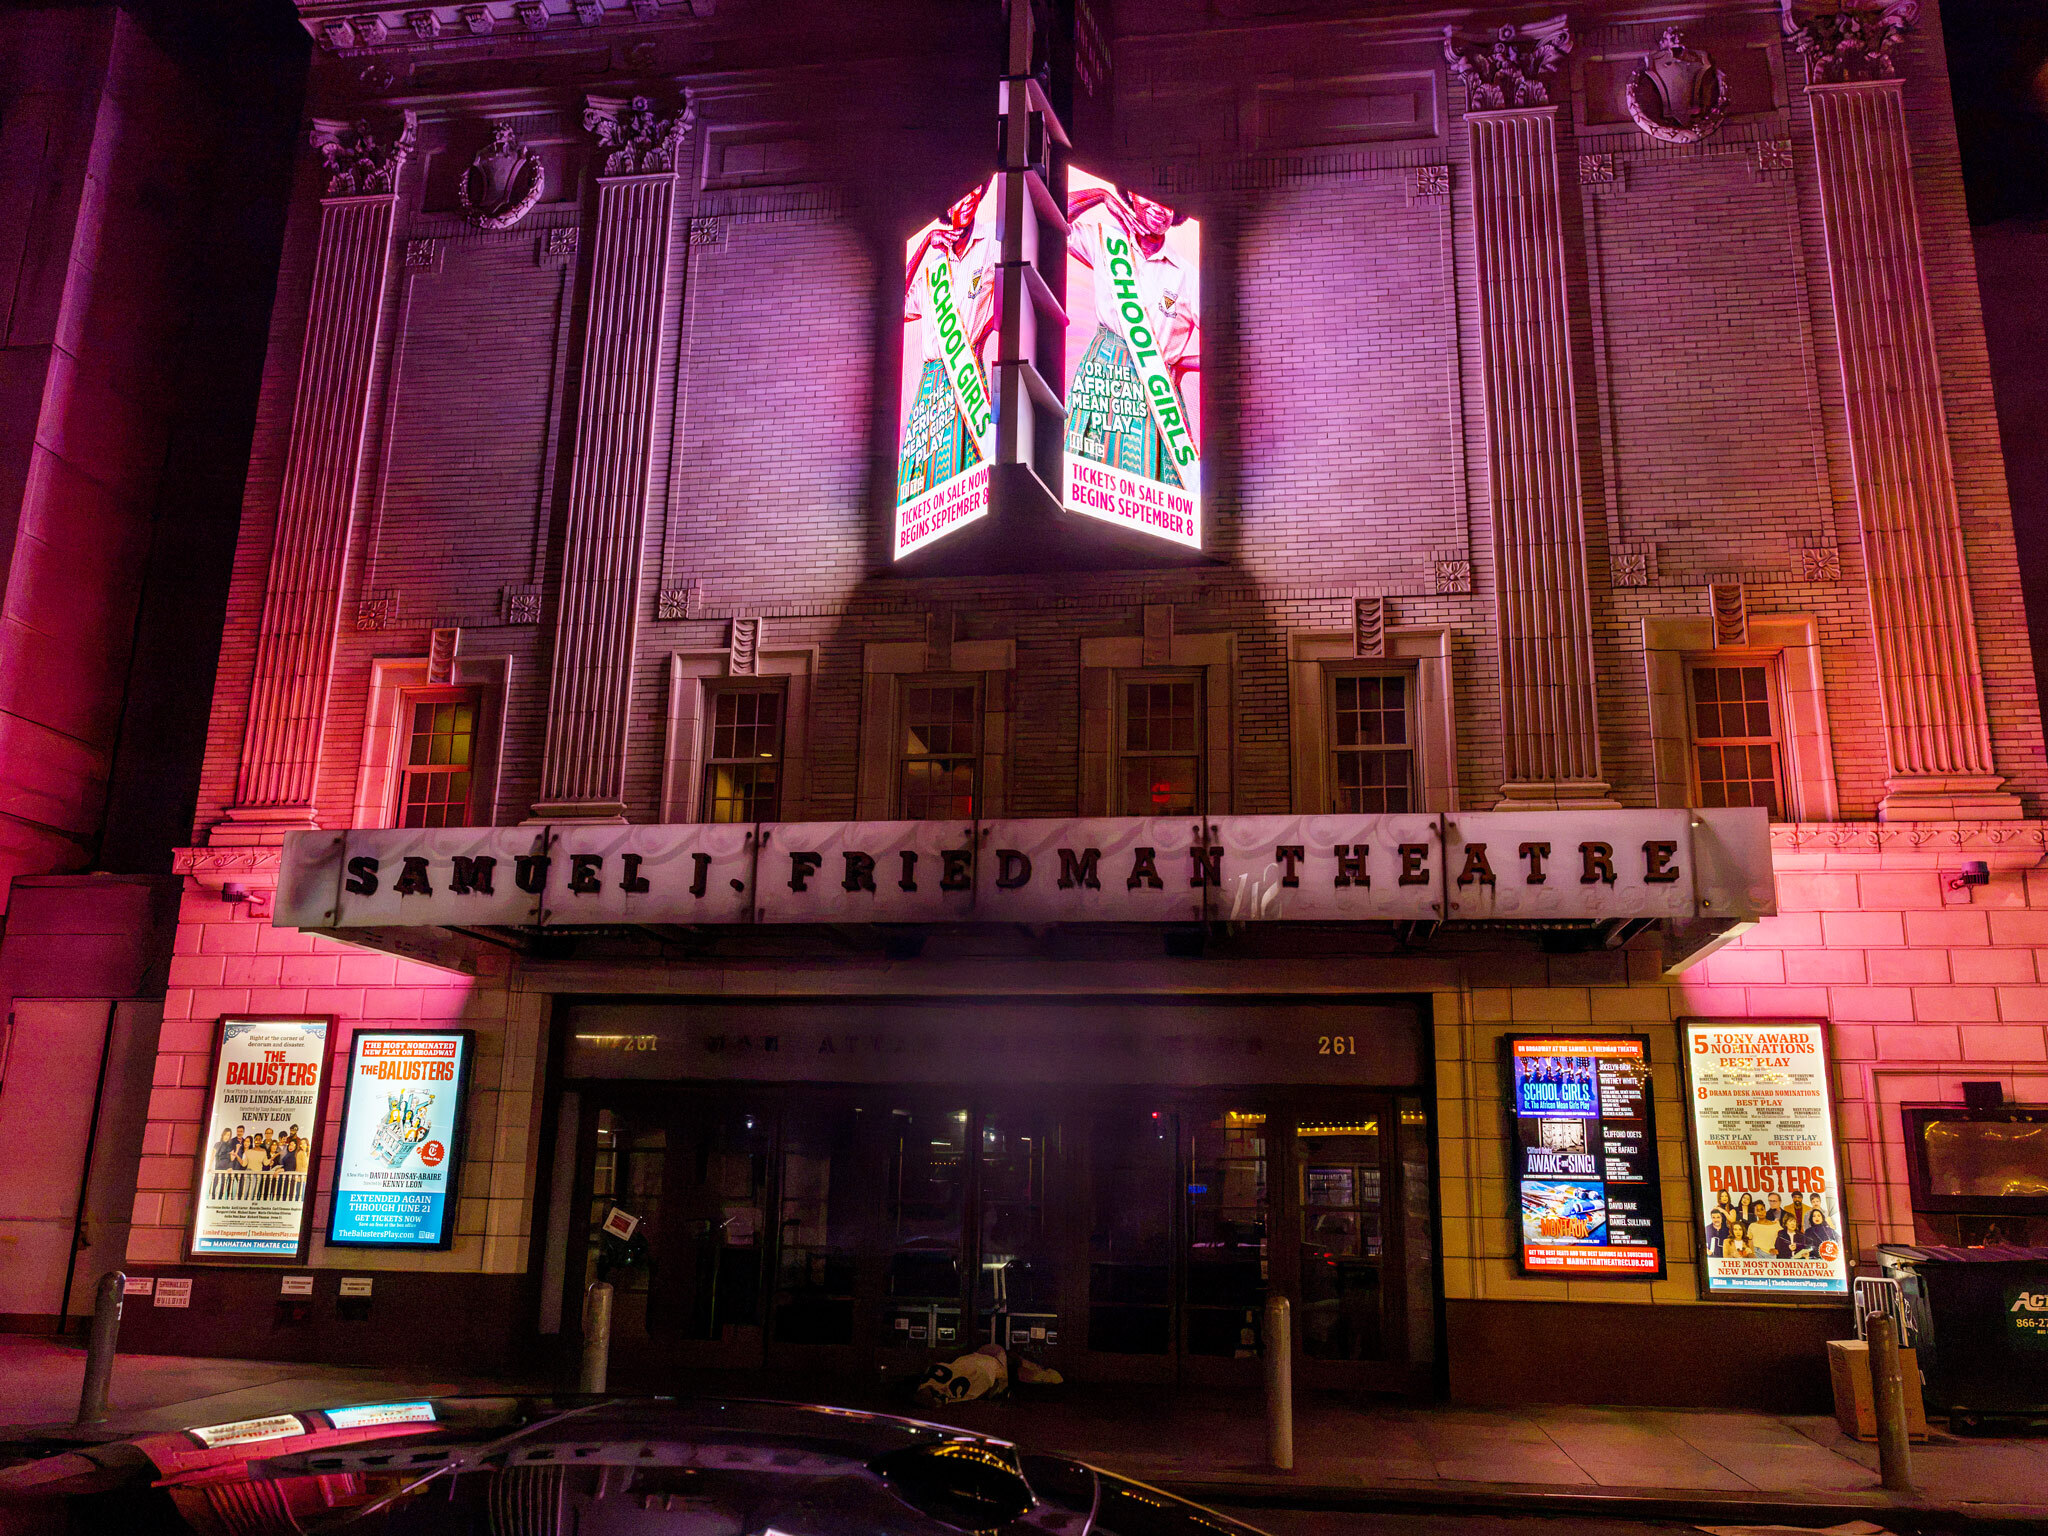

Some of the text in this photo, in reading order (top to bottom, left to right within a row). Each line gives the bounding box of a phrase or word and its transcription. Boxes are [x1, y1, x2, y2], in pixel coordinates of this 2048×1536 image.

[931, 262, 992, 438] SCHOOL GIRLS
[1106, 236, 1195, 466] SCHOOL GIRLS
[1084, 361, 1131, 381] OR, THE
[928, 382, 945, 405] THE
[1072, 375, 1145, 402] AFRICAN
[905, 388, 955, 442] AFRICAN
[1072, 393, 1148, 418] MEAN GIRLS
[903, 404, 956, 461] MEAN GIRLS
[1091, 412, 1133, 434] PLAY
[915, 430, 945, 468] PLAY
[902, 467, 990, 527] TICKETS ON SALE NOW
[1072, 463, 1193, 516] TICKETS ON SALE NOW
[900, 487, 989, 548] BEGINS SEPTEMBER 8
[1072, 483, 1194, 536] BEGINS SEPTEMBER 8
[345, 840, 1681, 898] SAMUEL J. FRIEDMAN THEATRE
[1318, 1036, 1356, 1054] 261
[1694, 1033, 1809, 1055] 5 TONY AWARD
[1711, 1043, 1815, 1054] NOMINATIONS
[264, 1050, 287, 1063] THE
[1719, 1057, 1791, 1067] BEST PLAY
[226, 1062, 318, 1086] BALUSTERS
[360, 1060, 455, 1081] THE BALUSTERS
[224, 1094, 314, 1105] DAVID LINDSAY-ABAIRE
[1523, 1083, 1560, 1101] SCHOOL
[1697, 1086, 1708, 1100] 8
[1580, 1102, 1590, 1110] Play
[242, 1112, 291, 1122] KENNY LEON
[1527, 1155, 1562, 1173] AWAKE
[1568, 1155, 1595, 1174] SING!
[1750, 1151, 1779, 1166] THE
[369, 1171, 389, 1180] DAVID
[390, 1172, 442, 1181] LINDSAY-ABAIRE
[382, 1180, 405, 1188] KENNY
[406, 1181, 423, 1189] LEON
[1708, 1165, 1826, 1194] BALUSTERS
[349, 1203, 431, 1213] THROUGH JUNE 21
[350, 1194, 432, 1204] EXTENDED AGAIN
[355, 1214, 370, 1222] GET
[404, 1215, 422, 1224] NOW
[1540, 1218, 1589, 1237] MONTAUK
[212, 1240, 252, 1248] MANHATTAN
[338, 1229, 414, 1240] TheBalustersPlay.com
[1721, 1260, 1828, 1270] THE MOST NOMINATED
[1741, 1268, 1765, 1277] PLAY
[1767, 1268, 1781, 1276] ON
[1783, 1269, 1835, 1277] BROADWAY
